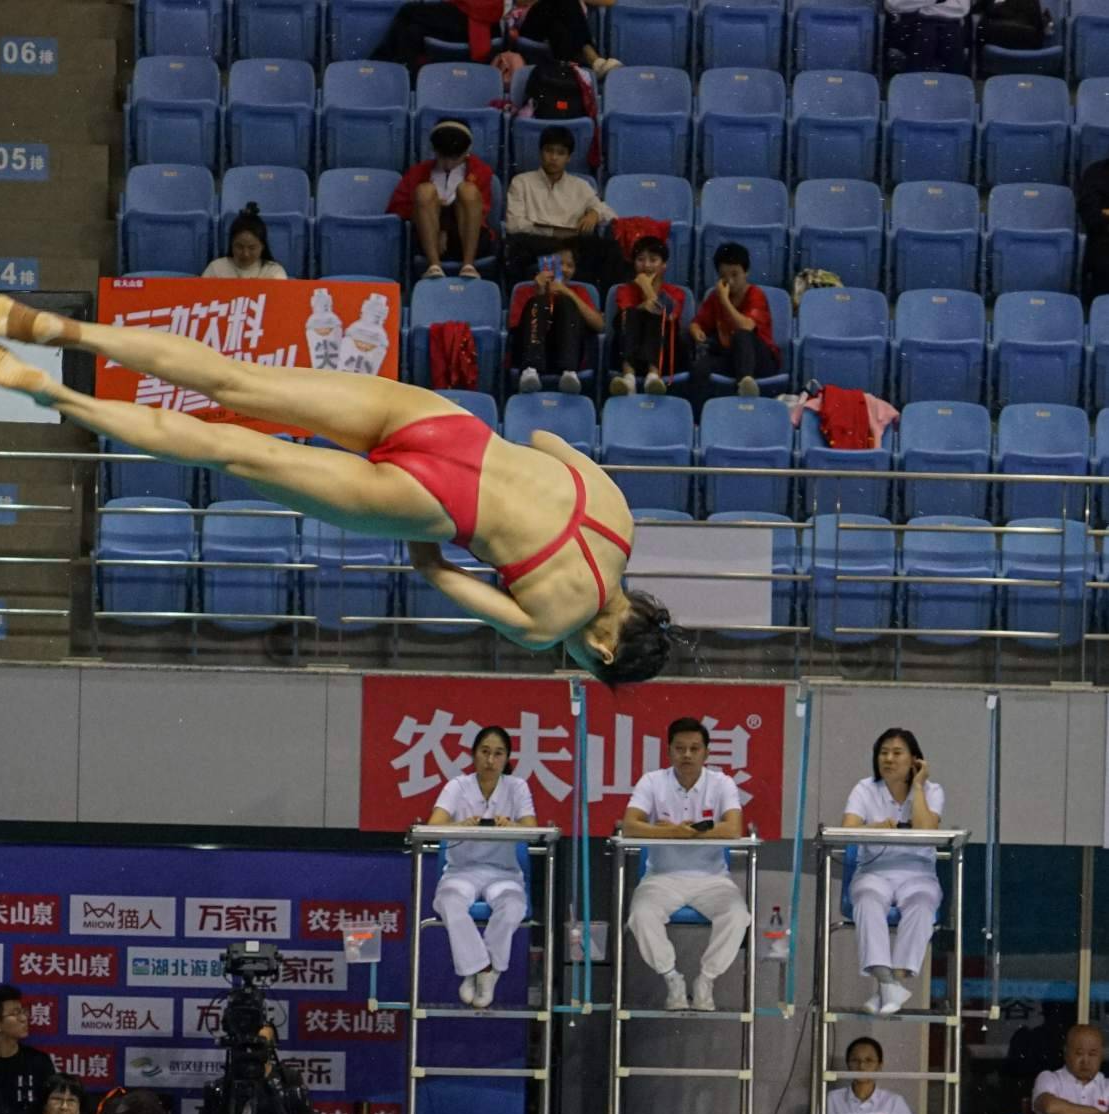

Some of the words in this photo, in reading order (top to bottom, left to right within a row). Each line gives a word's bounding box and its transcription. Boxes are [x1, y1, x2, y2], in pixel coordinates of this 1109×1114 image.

[117, 908, 162, 931] 猫人
[198, 904, 277, 933] 万家乐
[19, 952, 111, 977] 农夫山泉
[266, 957, 334, 985] 家乐
[115, 1010, 160, 1031] 猫人
[305, 1009, 396, 1034] 农夫山泉
